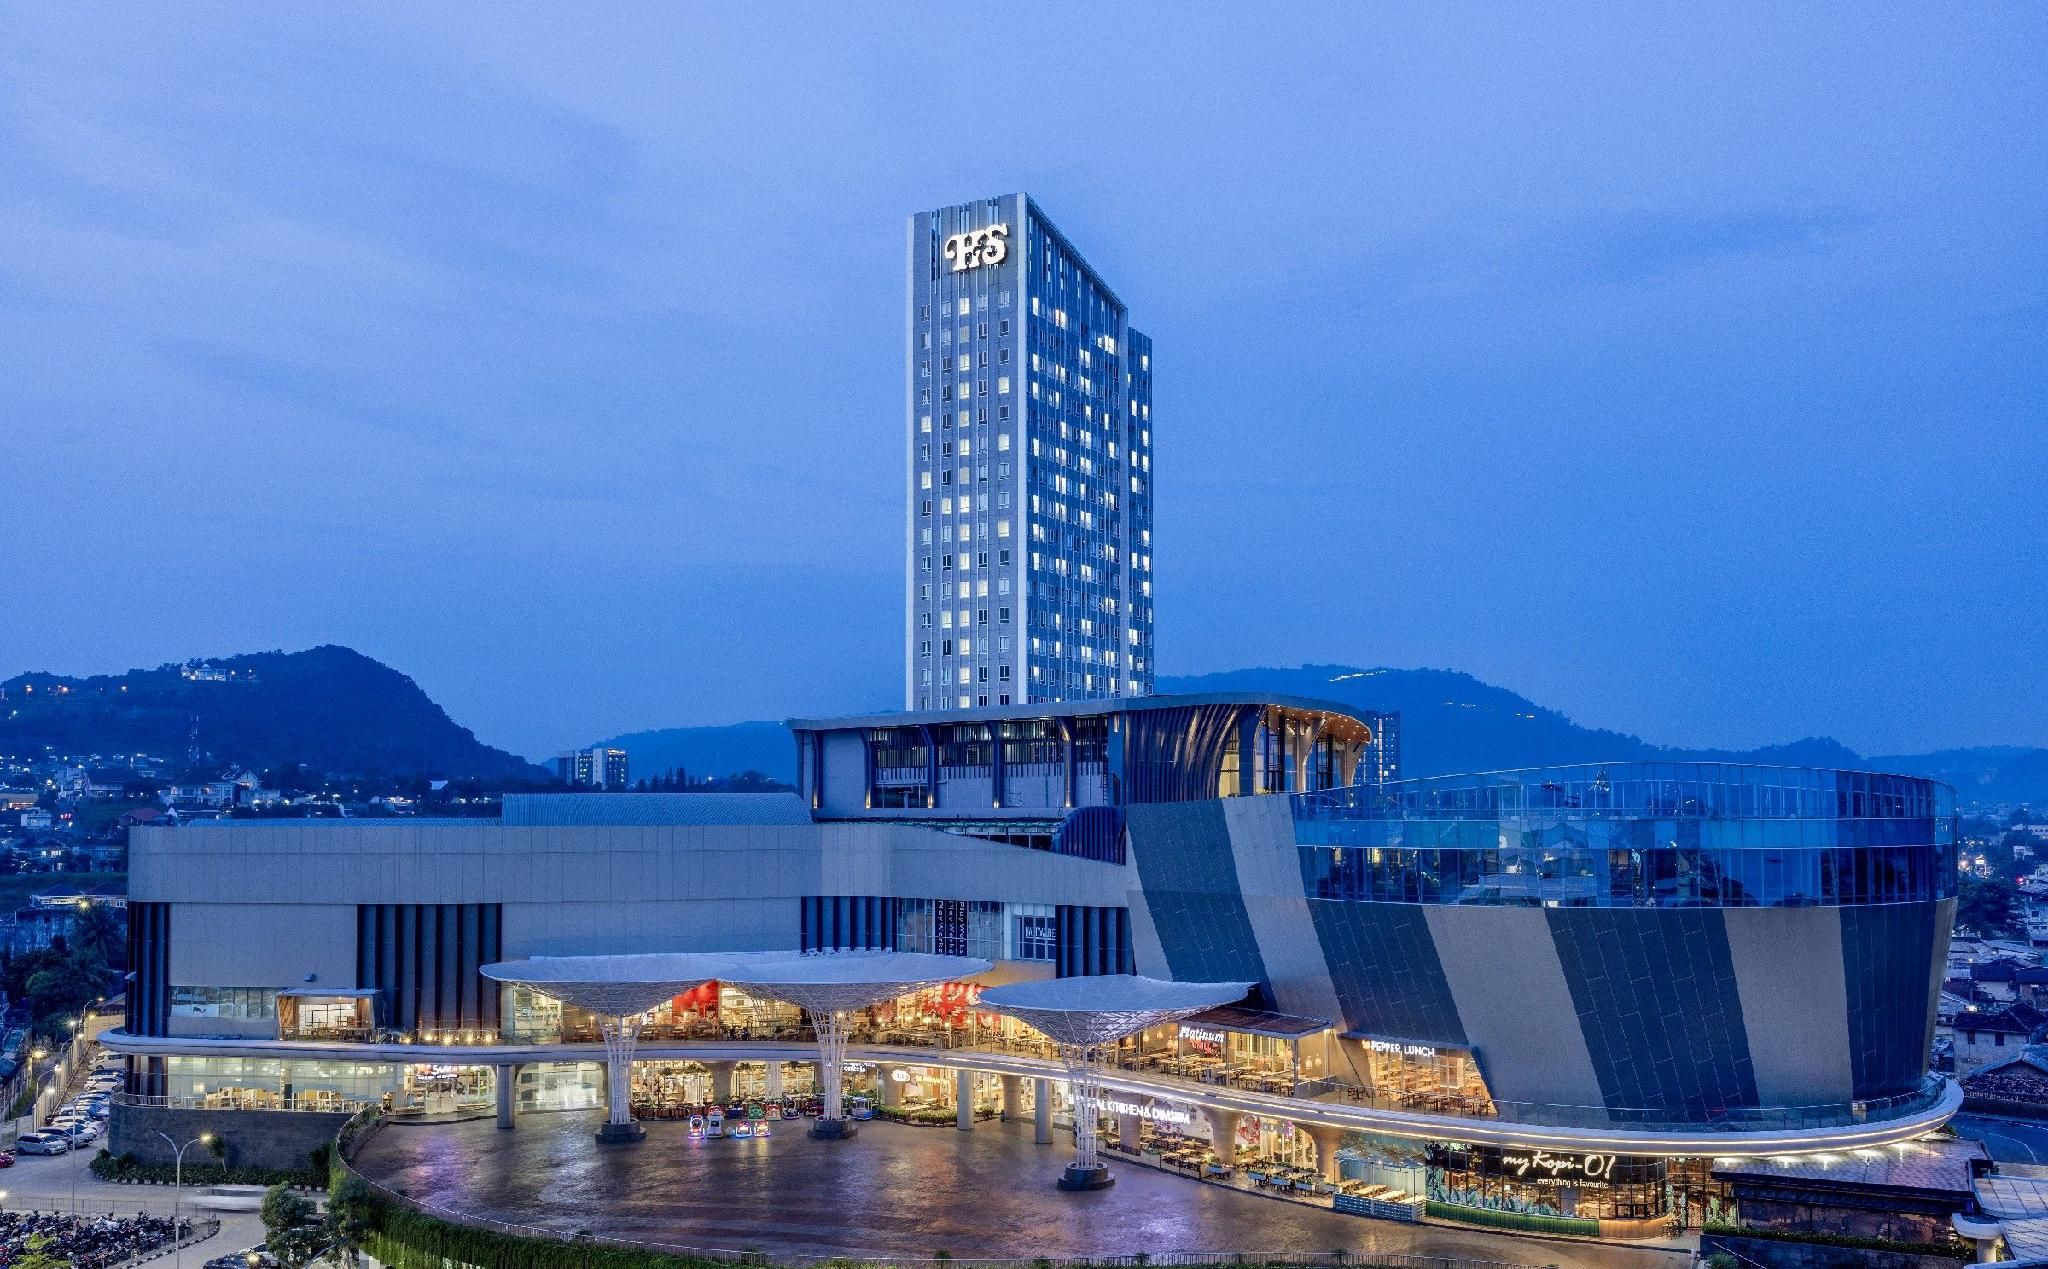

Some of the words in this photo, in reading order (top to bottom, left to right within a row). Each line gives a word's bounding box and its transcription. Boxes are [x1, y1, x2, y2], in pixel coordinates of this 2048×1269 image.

[1179, 1026, 1224, 1042] Platinum
[1371, 1040, 1401, 1053] PEPPER
[1404, 1045, 1435, 1058] LUNCH
[1107, 1101, 1143, 1117] KITCHEN
